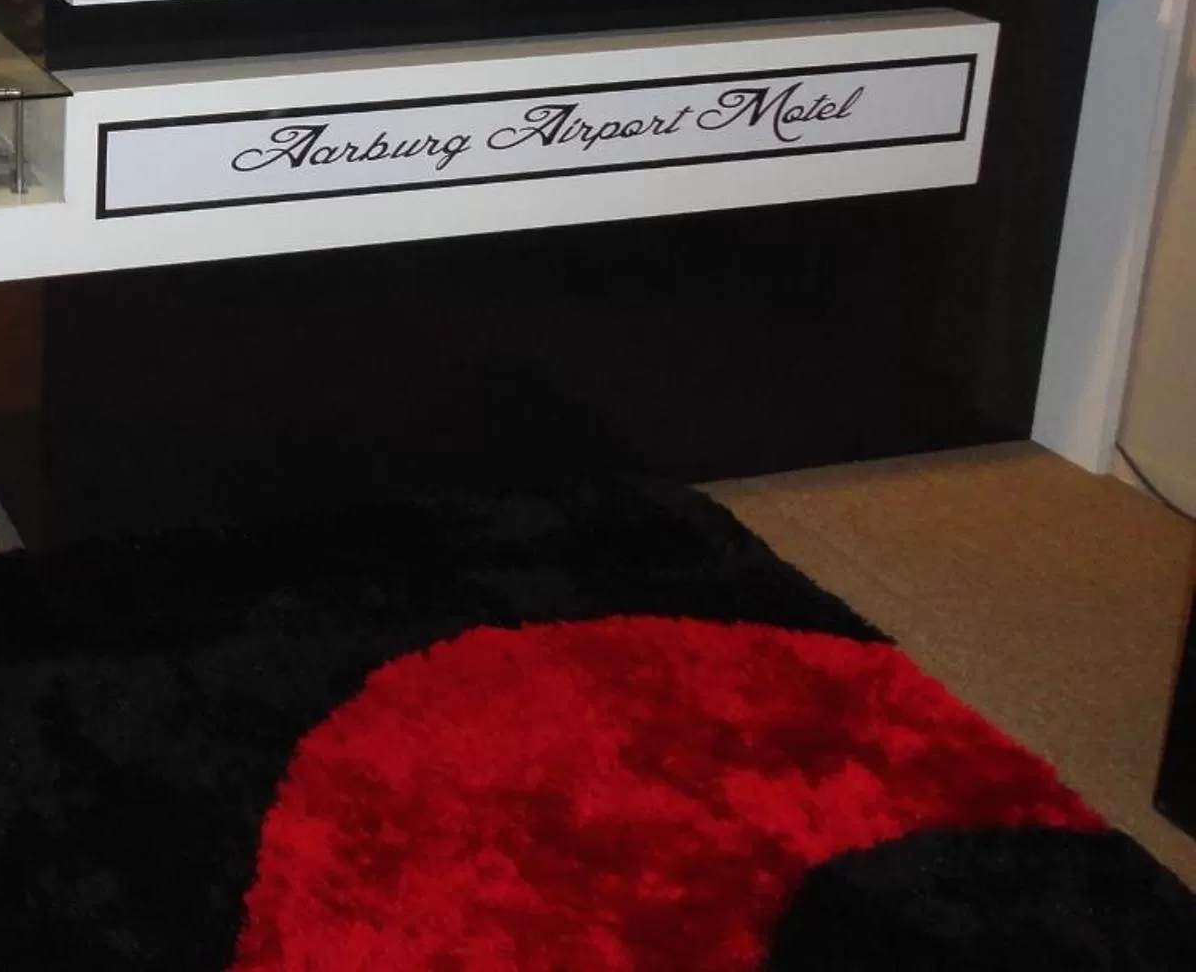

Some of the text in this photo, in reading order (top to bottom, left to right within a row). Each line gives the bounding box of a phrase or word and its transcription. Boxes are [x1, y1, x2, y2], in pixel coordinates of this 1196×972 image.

[231, 81, 865, 172] Aarburg Airport Motel
